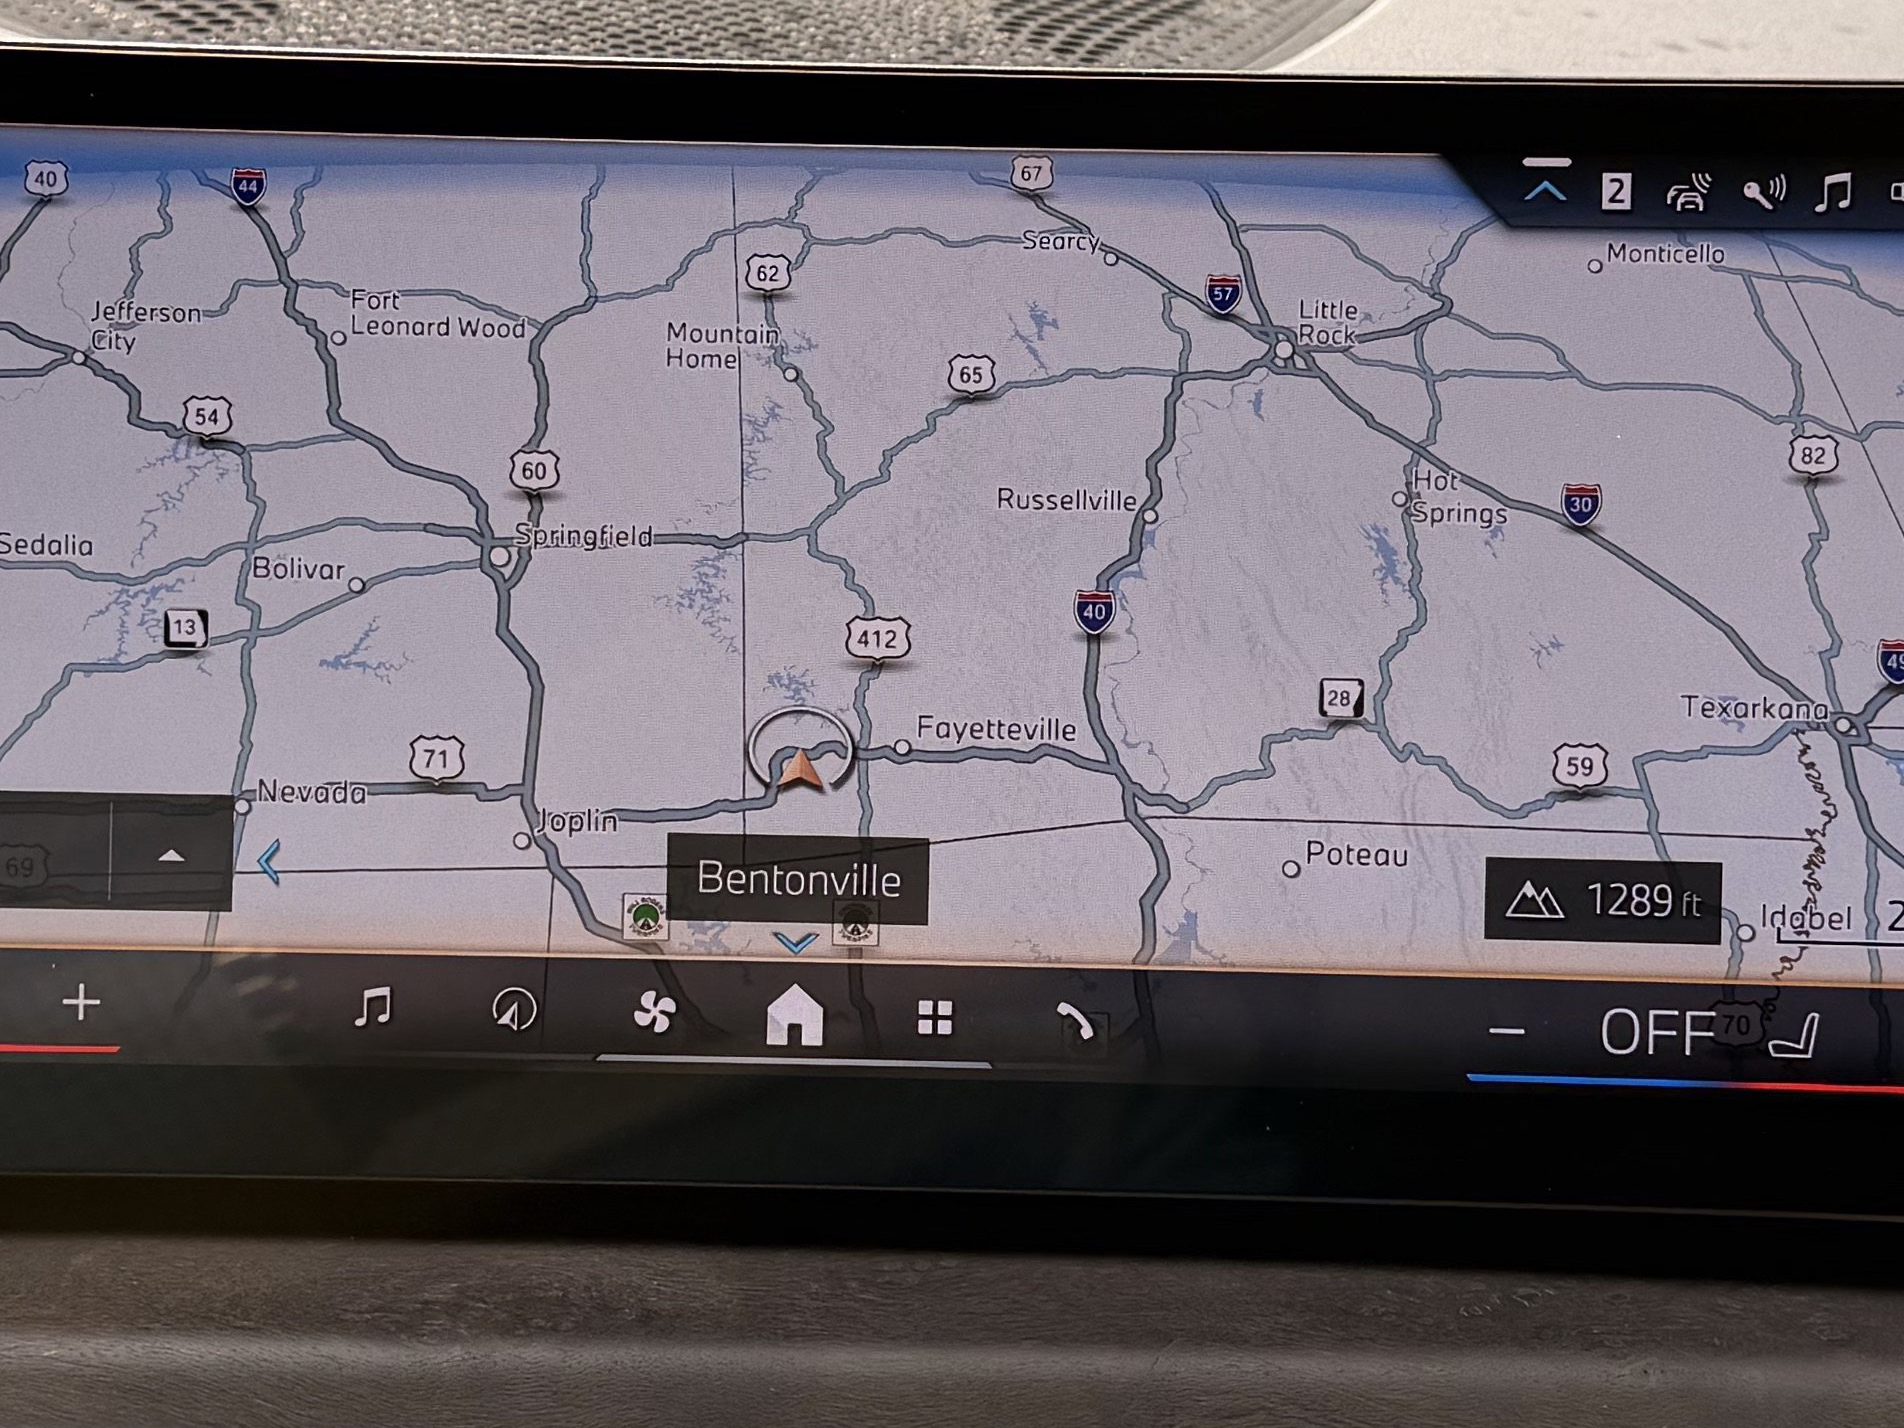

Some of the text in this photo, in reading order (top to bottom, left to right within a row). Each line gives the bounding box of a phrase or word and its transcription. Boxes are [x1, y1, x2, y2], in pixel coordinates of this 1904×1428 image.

[35, 170, 57, 188] 40
[1021, 166, 1042, 182] 67
[239, 180, 257, 193] 44
[1608, 179, 1625, 203] 2
[1023, 231, 1100, 255] Searcy
[1607, 243, 1724, 264] Monticello
[757, 266, 779, 282] 62
[352, 290, 399, 310] Fort
[1213, 287, 1232, 301] 57
[92, 301, 201, 324] Jefferson
[1300, 301, 1358, 321] Little
[352, 316, 526, 339] Leonard Wood
[667, 322, 780, 346] Mountain
[1299, 325, 1355, 345] Rock
[92, 331, 136, 354] City
[667, 349, 736, 369] Home
[960, 367, 983, 384] 65
[197, 409, 218, 426] 54
[1802, 448, 1825, 464] 82
[522, 463, 546, 480] 60
[1414, 470, 1458, 490] Hot
[998, 488, 1136, 512] Russellville
[1570, 497, 1592, 512] 30
[1412, 502, 1507, 526] Springs
[515, 523, 652, 549] Springfield
[253, 558, 344, 581] Bolivar
[1083, 604, 1105, 620] 40
[174, 620, 195, 636] 13
[858, 631, 896, 648] 412
[1328, 690, 1350, 706] 28
[1682, 695, 1829, 721] Texarkana
[918, 717, 1076, 743] Fayetteville
[424, 749, 447, 768] 71
[1567, 758, 1592, 775] 59
[259, 780, 366, 805] Nevada
[537, 809, 617, 833] Joplin
[1307, 842, 1408, 867] Poteau
[699, 859, 900, 898] Bentonville
[1589, 885, 1701, 917] 1289 ft
[1762, 904, 1851, 931] Idabel
[1601, 1010, 1716, 1056] OFF
